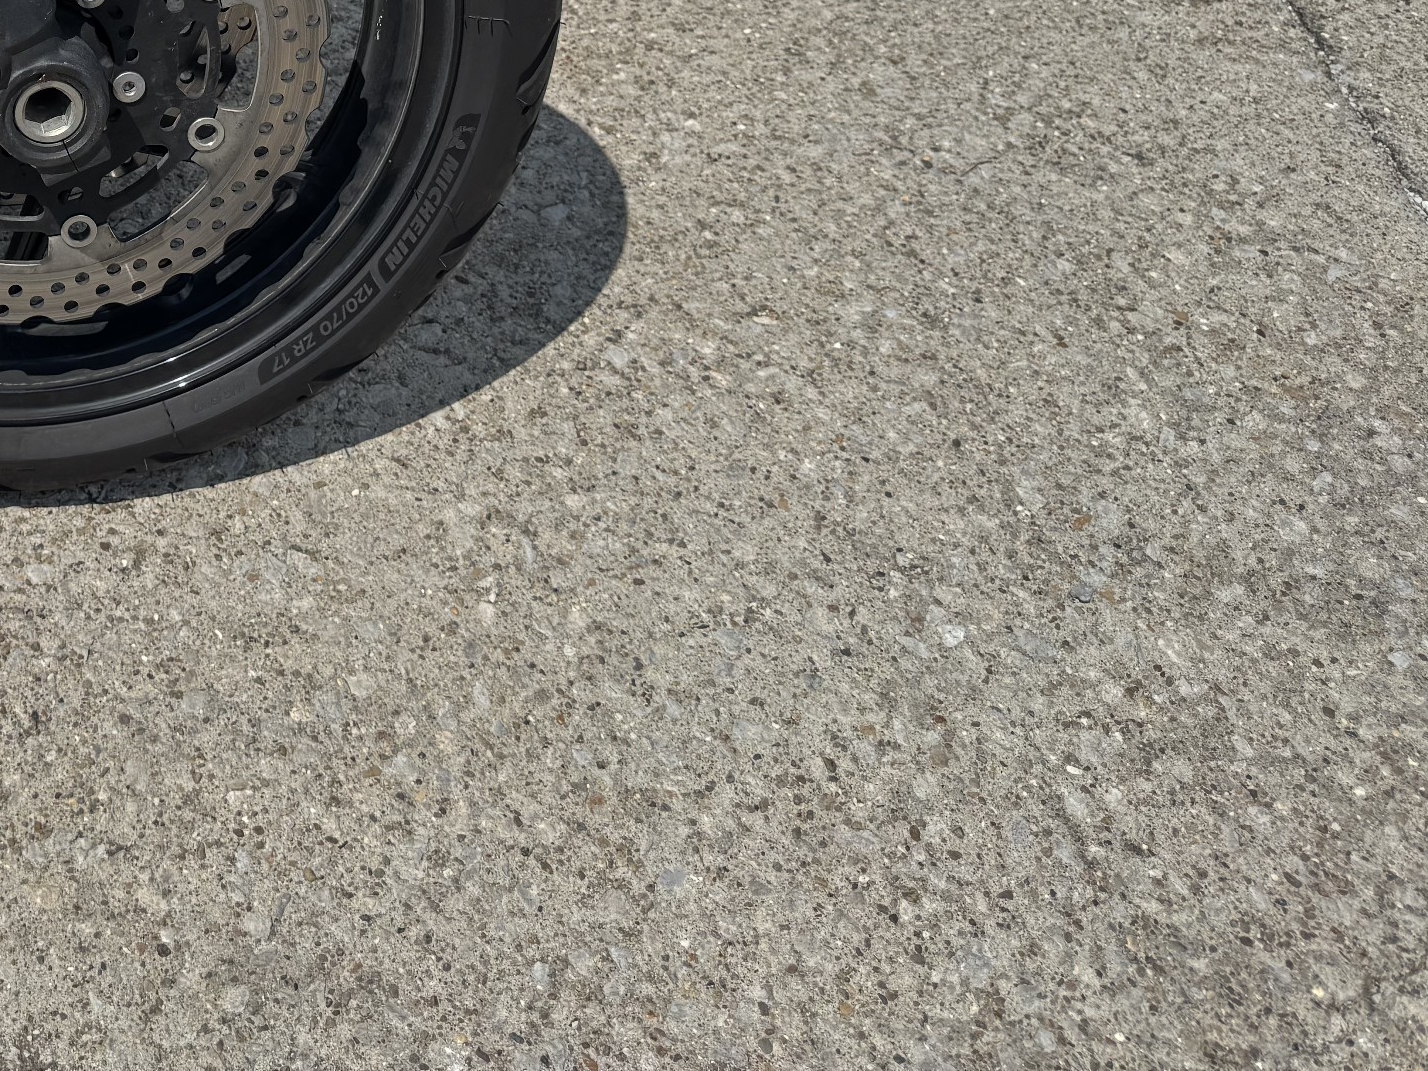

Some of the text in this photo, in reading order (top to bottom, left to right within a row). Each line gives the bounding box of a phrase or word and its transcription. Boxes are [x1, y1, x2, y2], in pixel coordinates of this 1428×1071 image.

[383, 153, 459, 270] MICHELIN
[320, 282, 373, 335] 120/70
[273, 352, 290, 373] 17
[291, 331, 317, 357] ZR
